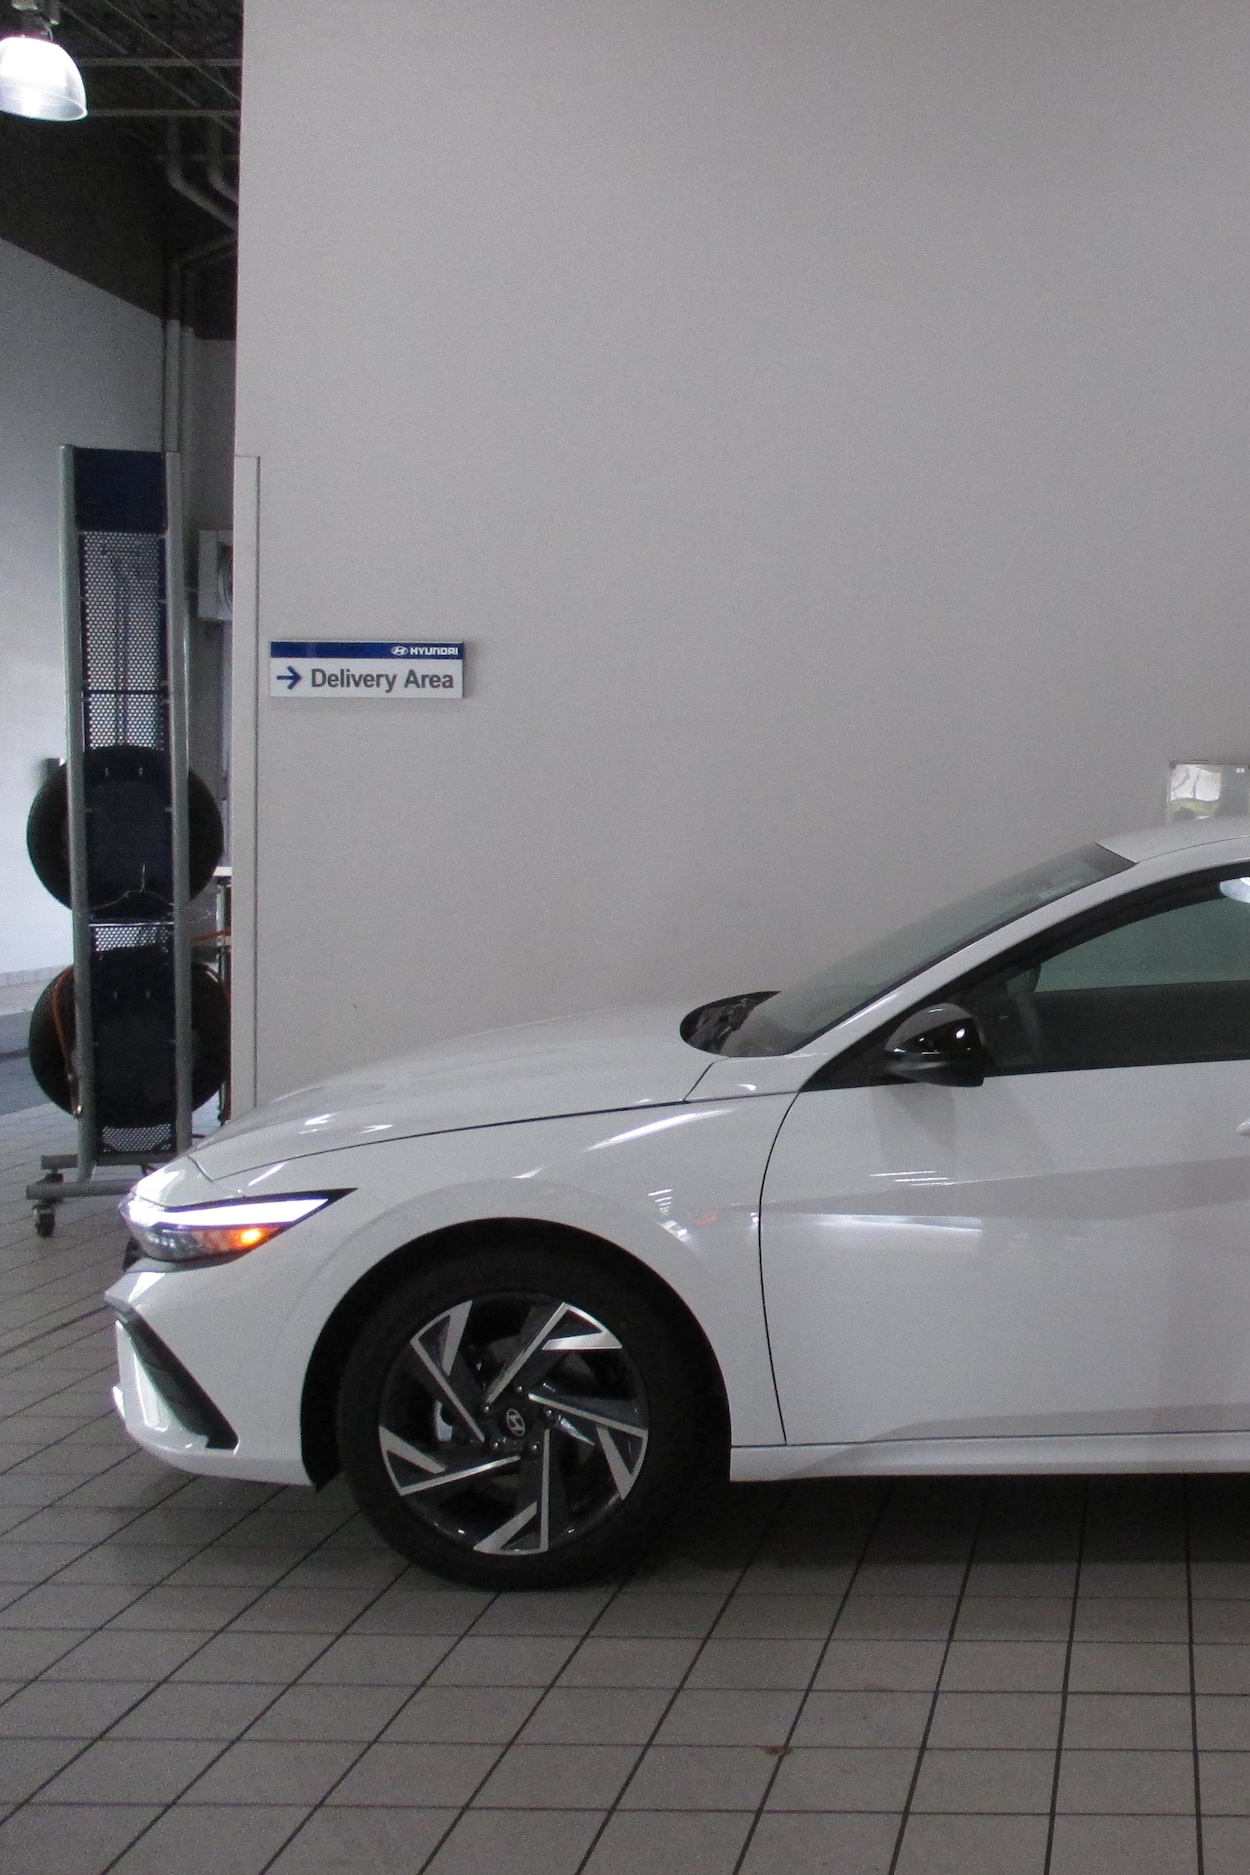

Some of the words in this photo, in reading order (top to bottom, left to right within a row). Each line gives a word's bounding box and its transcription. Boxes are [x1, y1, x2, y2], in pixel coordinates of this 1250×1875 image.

[409, 646, 459, 657] HYUNDAI
[311, 668, 397, 693] Delivery
[403, 669, 454, 689] Area
